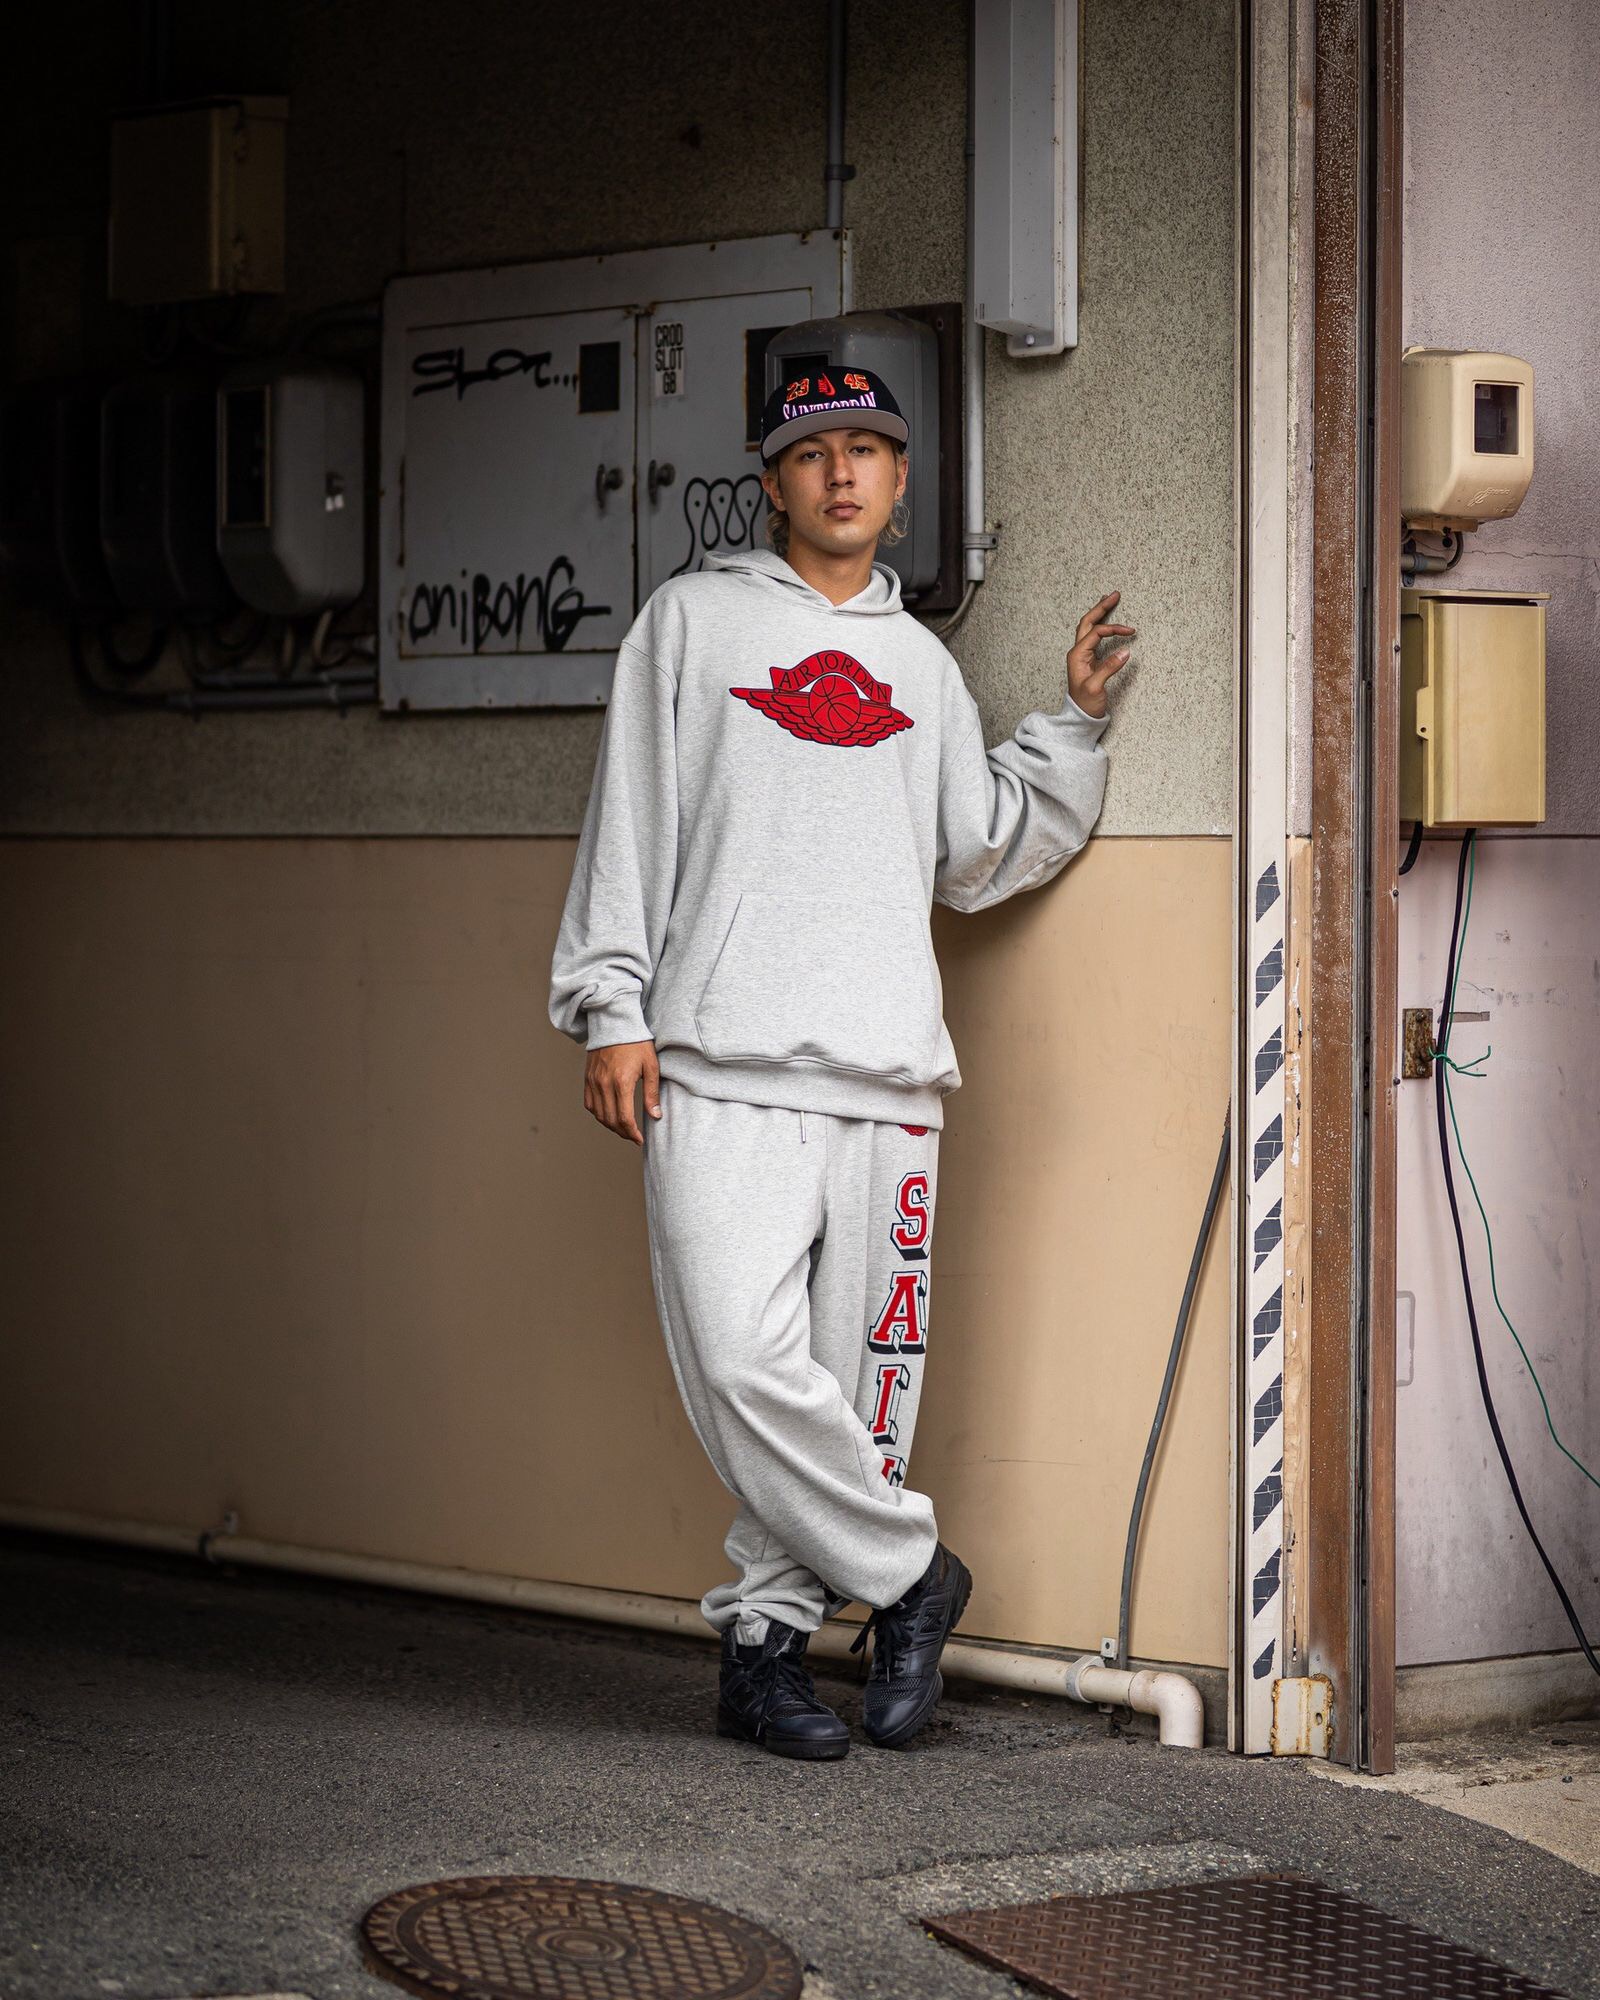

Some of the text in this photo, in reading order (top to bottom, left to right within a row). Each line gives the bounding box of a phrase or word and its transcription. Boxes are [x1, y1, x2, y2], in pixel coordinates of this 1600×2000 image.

[655, 347, 684, 372] SLOT
[787, 378, 810, 402] 23
[843, 373, 870, 392] 45
[778, 653, 888, 703] AIR JORDAN
